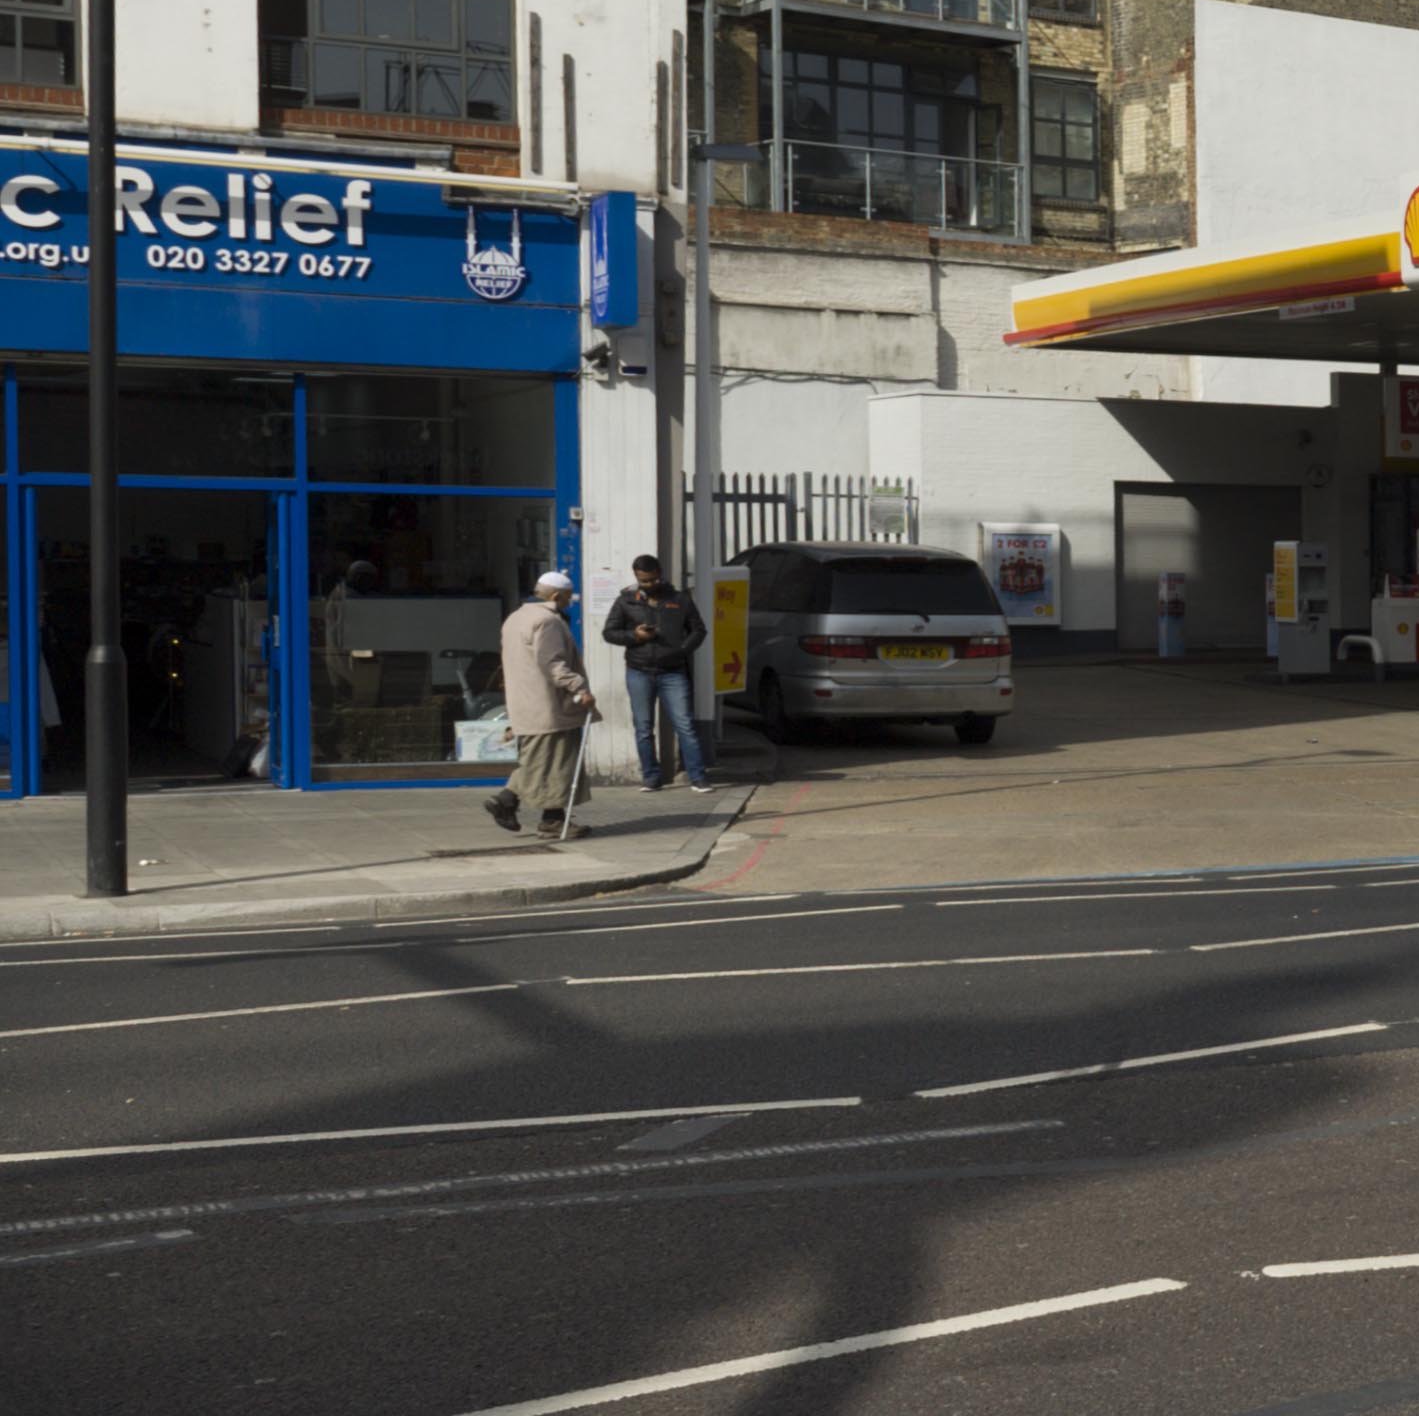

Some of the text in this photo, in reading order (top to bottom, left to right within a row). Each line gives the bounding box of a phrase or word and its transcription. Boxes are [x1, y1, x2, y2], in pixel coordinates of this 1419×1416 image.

[114, 165, 371, 246] Relief
[0, 241, 90, 267] .org.u
[147, 245, 371, 279] 020 3327 0677
[462, 263, 526, 278] ISLAMIC
[1007, 538, 1028, 549] FOR
